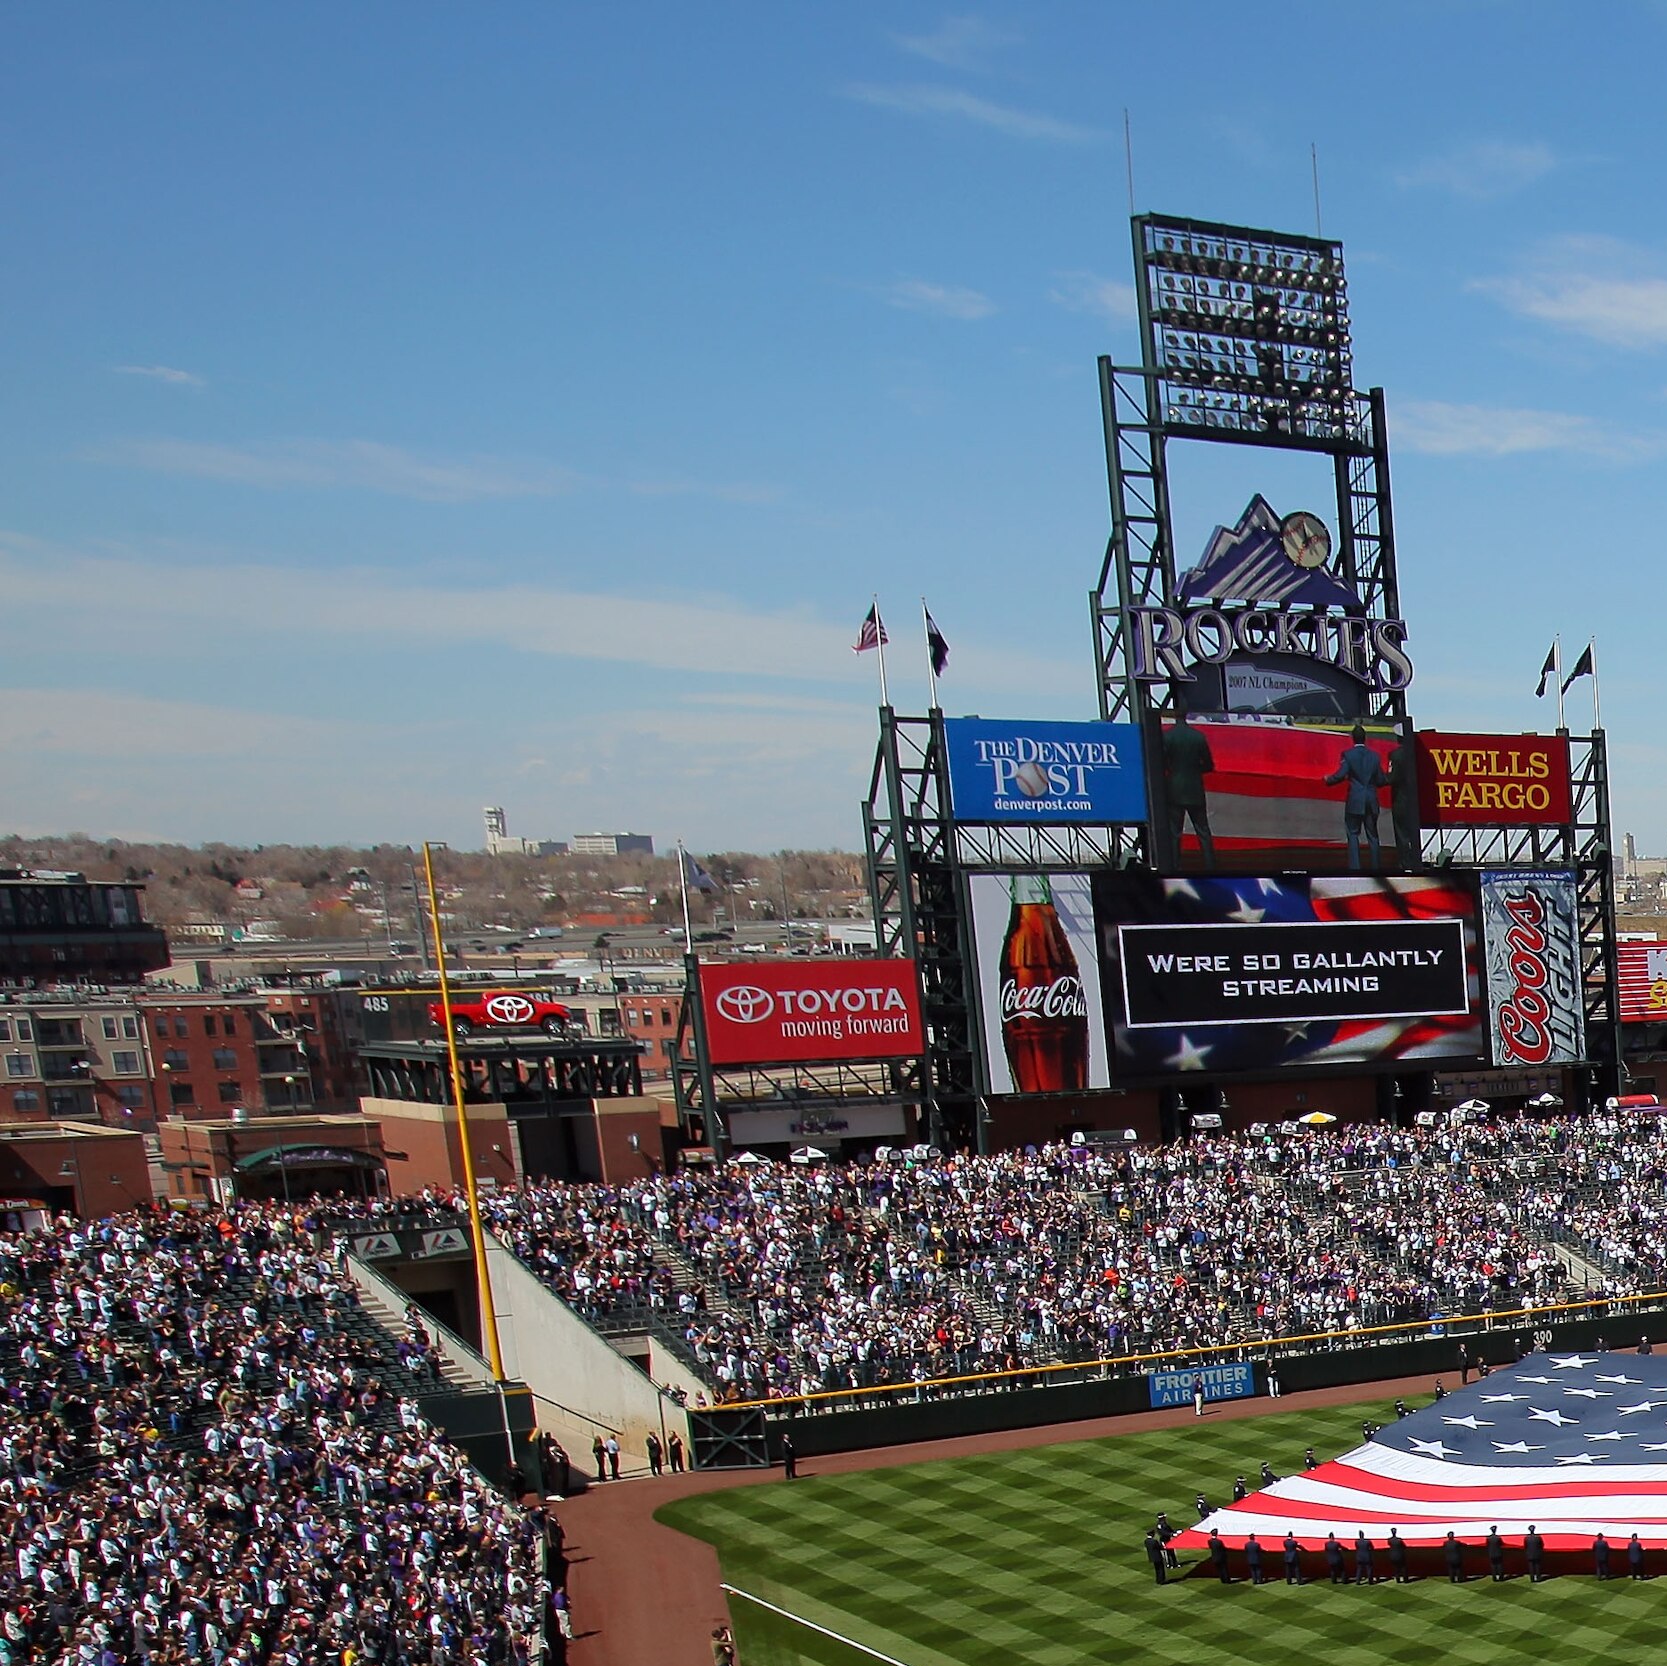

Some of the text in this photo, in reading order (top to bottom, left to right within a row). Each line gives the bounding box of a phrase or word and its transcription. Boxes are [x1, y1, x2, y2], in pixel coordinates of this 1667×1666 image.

[1128, 605, 1413, 691] ROCKIES
[1228, 675, 1308, 691] 2007 NL Champions
[975, 737, 1120, 764] THE DENVER
[1429, 749, 1550, 779] WELLS
[994, 798, 1092, 812] denverpost.com
[1436, 782, 1550, 810] FARGO
[1147, 949, 1444, 974] WERE SO GALLANTLY
[1223, 976, 1380, 997] STREAMING
[1499, 891, 1551, 1064] Coors
[1545, 898, 1579, 1057] LIGHT
[364, 997, 389, 1012] 485
[777, 988, 907, 1014] TOYOTA
[1001, 975, 1090, 1021] Coca-Cola
[781, 1013, 910, 1040] moving forward
